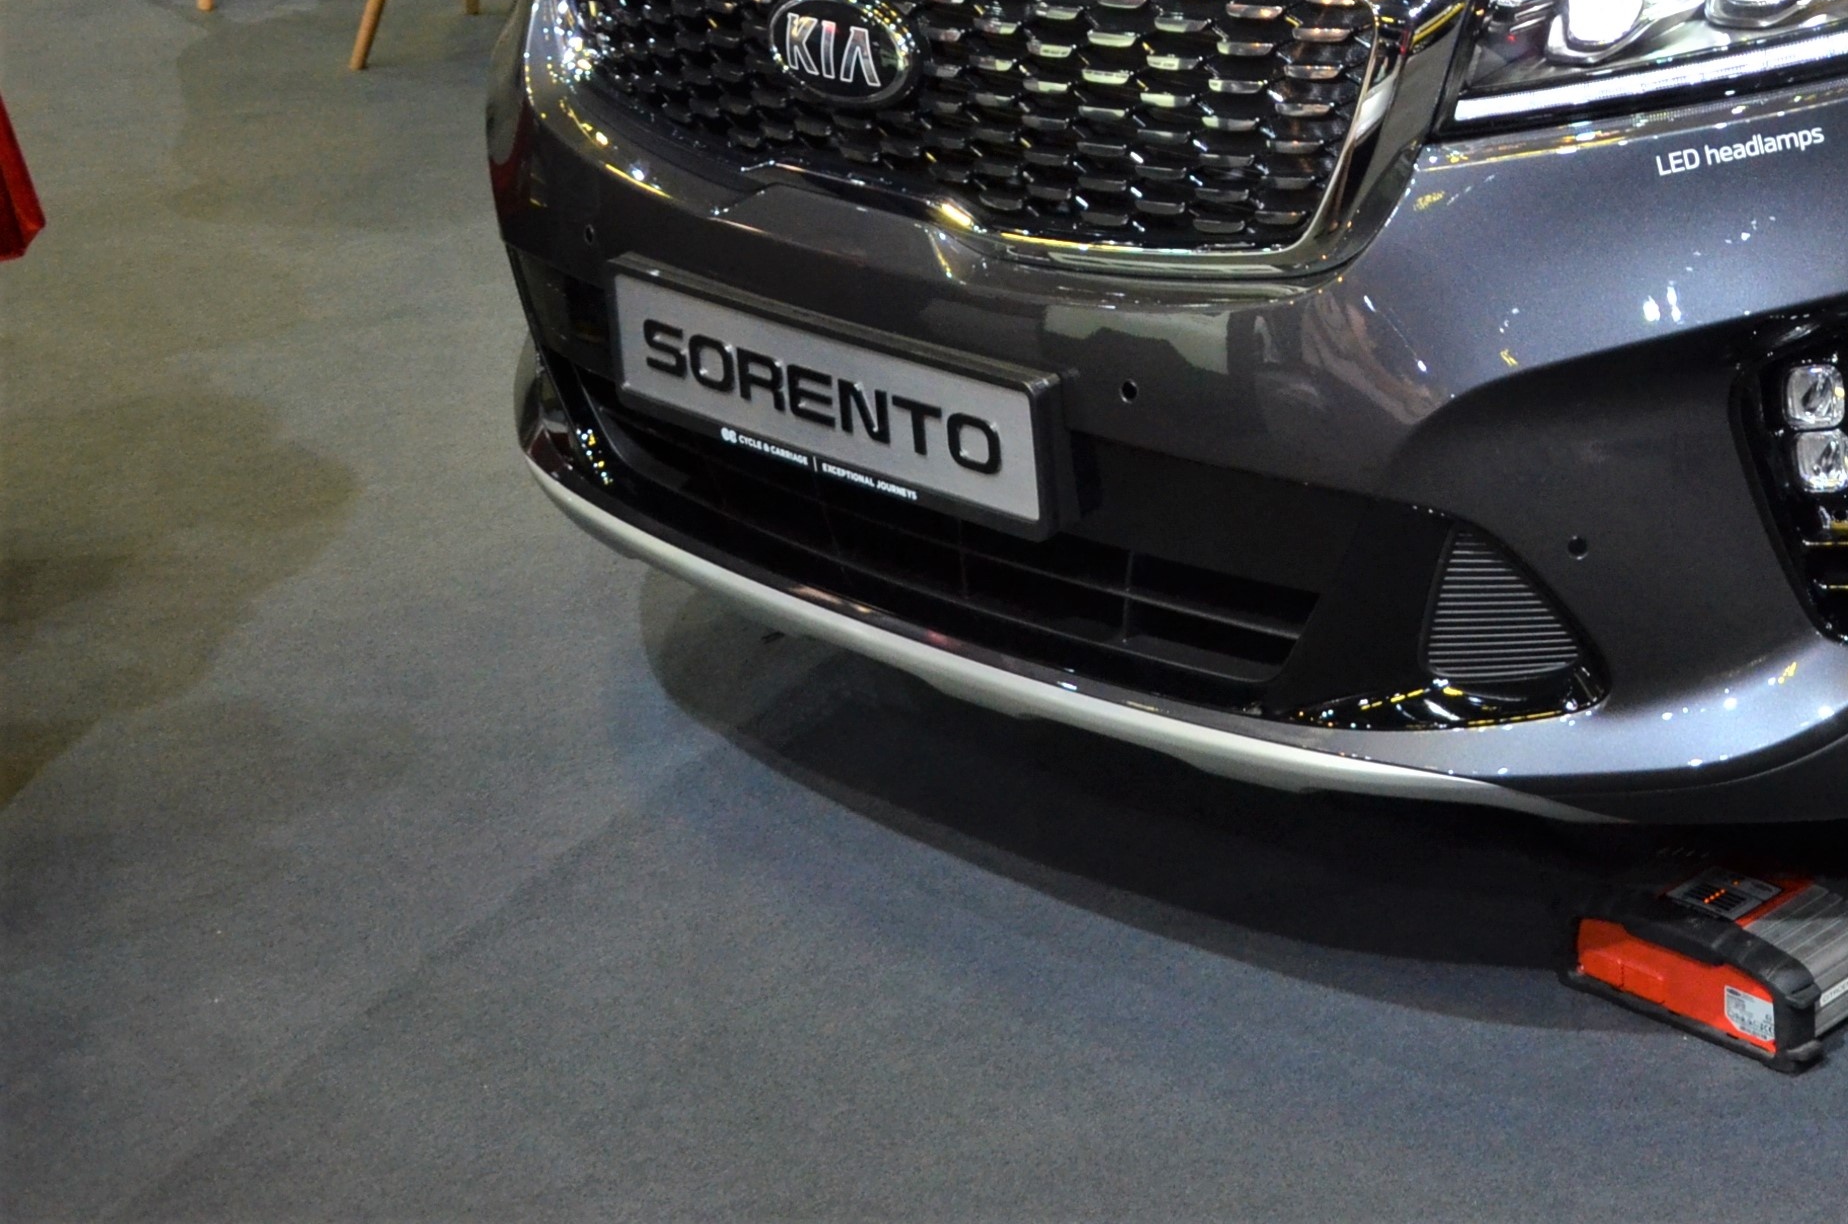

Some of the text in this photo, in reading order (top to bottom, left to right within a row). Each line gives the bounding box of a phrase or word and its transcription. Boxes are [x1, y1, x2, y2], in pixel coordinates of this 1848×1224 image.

[785, 11, 882, 88] KIA
[1655, 127, 1825, 176] LED headlamps
[643, 318, 1003, 475] SORENTO
[738, 435, 762, 450] CYCLE
[770, 444, 809, 466] CARRIAGE
[821, 462, 875, 487] EXCEPTIONAL
[876, 480, 918, 501] JOURNEYS
